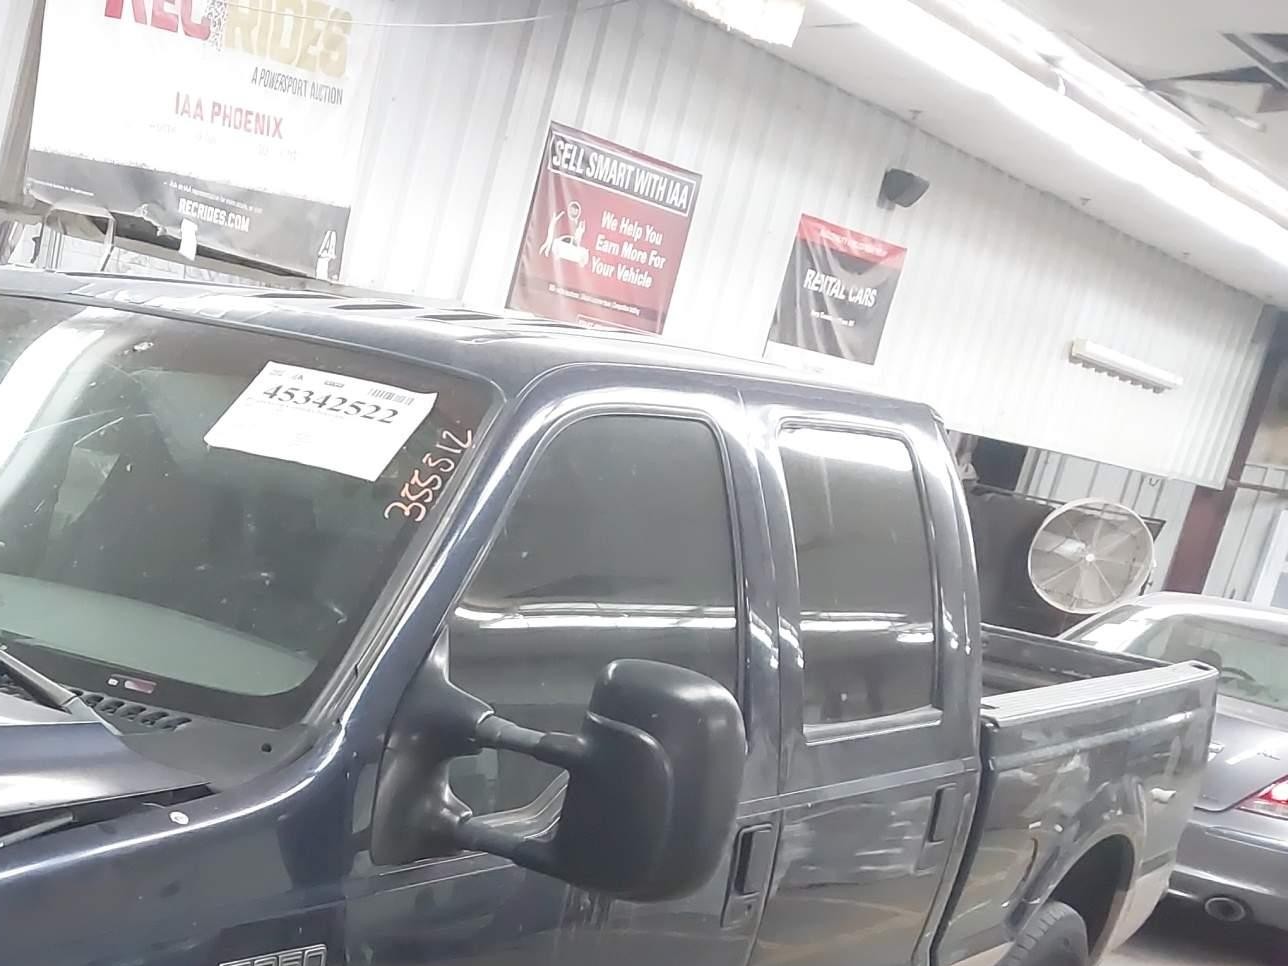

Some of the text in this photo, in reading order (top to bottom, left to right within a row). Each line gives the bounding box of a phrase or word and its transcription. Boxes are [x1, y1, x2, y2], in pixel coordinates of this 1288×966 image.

[251, 67, 344, 105] A POWERSPORT AUCTION
[174, 91, 205, 121] IAA
[210, 100, 284, 140] PHOENIX
[552, 140, 690, 210] SELL SMART WITH IAA
[178, 197, 251, 232] RECRIDES.COM
[601, 210, 619, 232] We
[619, 217, 643, 241] Help
[645, 224, 663, 246] You
[595, 234, 667, 269] Earn More For
[591, 256, 653, 288] Your Vehicle
[803, 268, 878, 307] RENTAL CARS
[263, 385, 399, 424] 45342522
